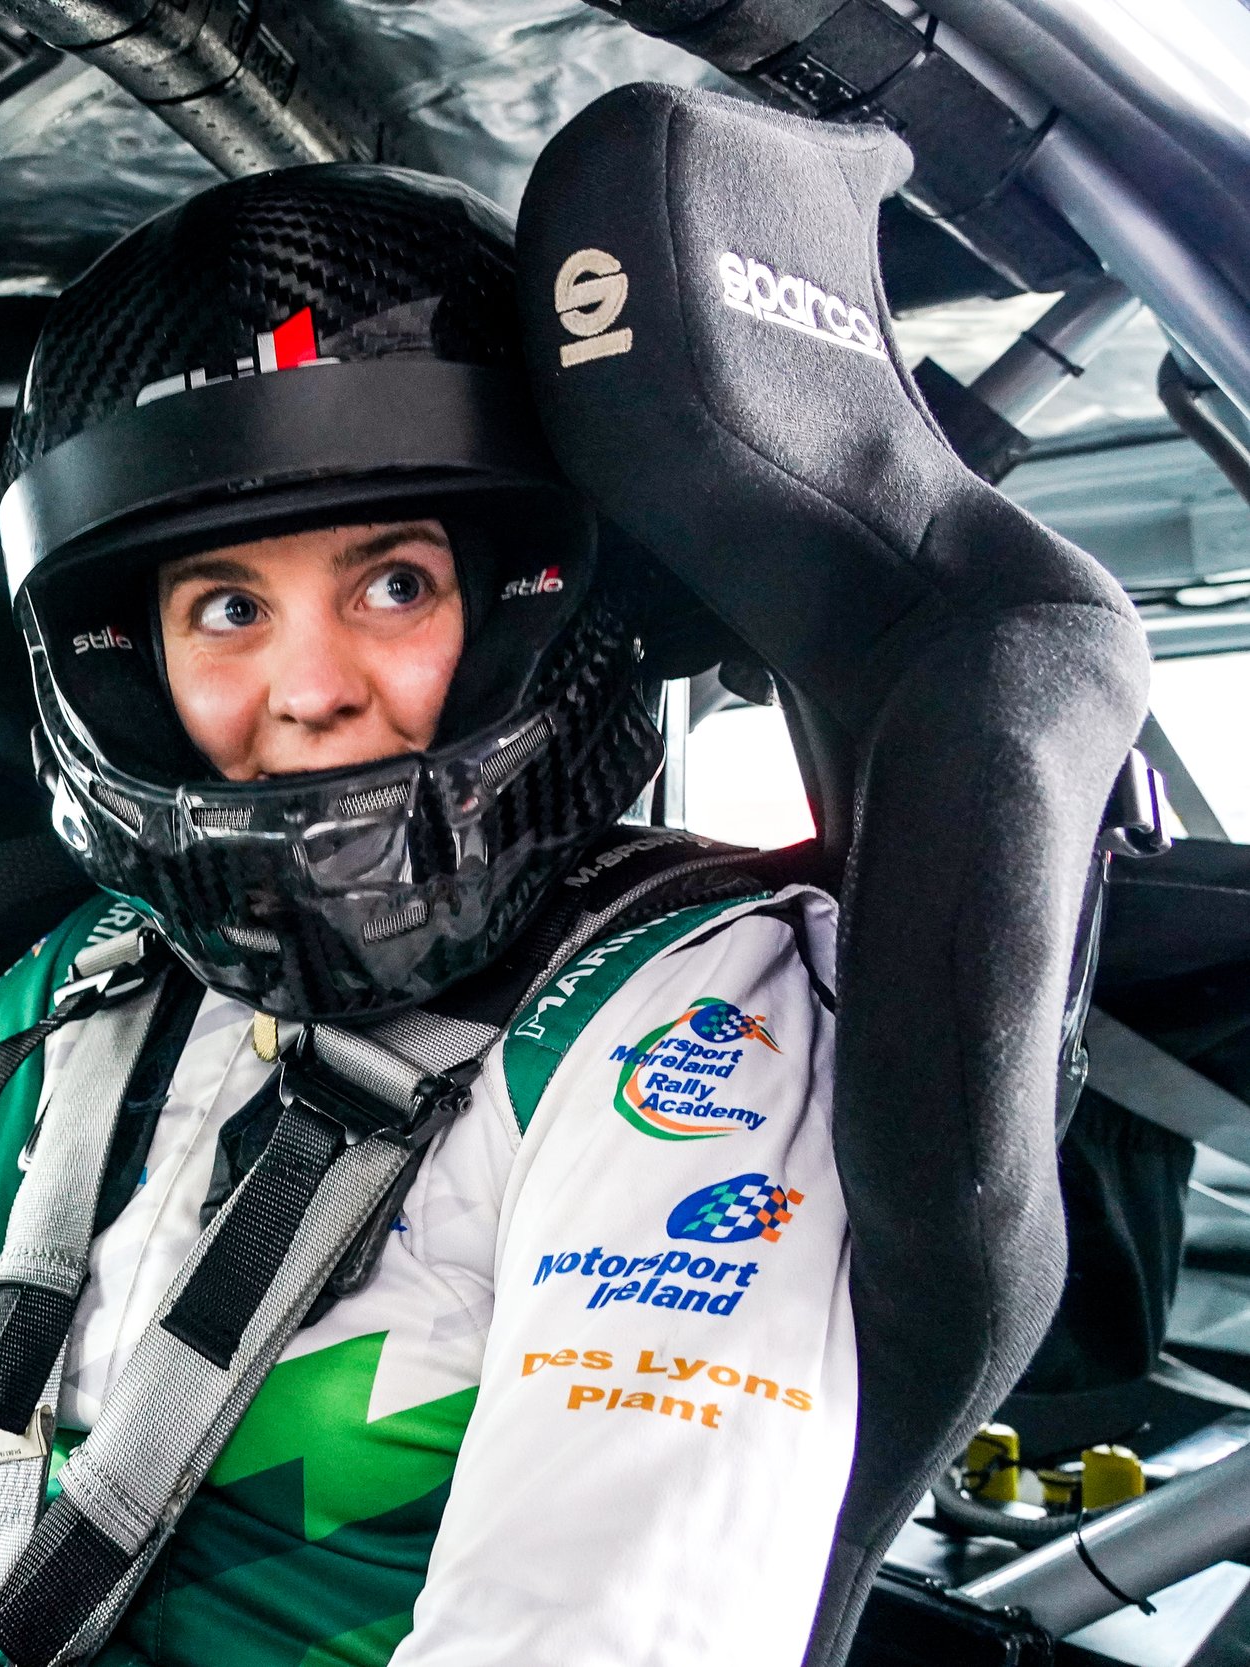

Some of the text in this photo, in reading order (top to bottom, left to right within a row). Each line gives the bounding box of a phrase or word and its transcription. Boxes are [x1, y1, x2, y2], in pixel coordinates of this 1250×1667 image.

[719, 251, 882, 352] sparco
[501, 567, 563, 600] stilo
[73, 625, 132, 655] stilo
[645, 1072, 716, 1102] Rally
[638, 1093, 767, 1130] Academy
[533, 1247, 759, 1287] Motorsport
[586, 1278, 744, 1316] Ireland
[521, 1349, 813, 1411] Des Lyons
[567, 1385, 722, 1429] Plant
